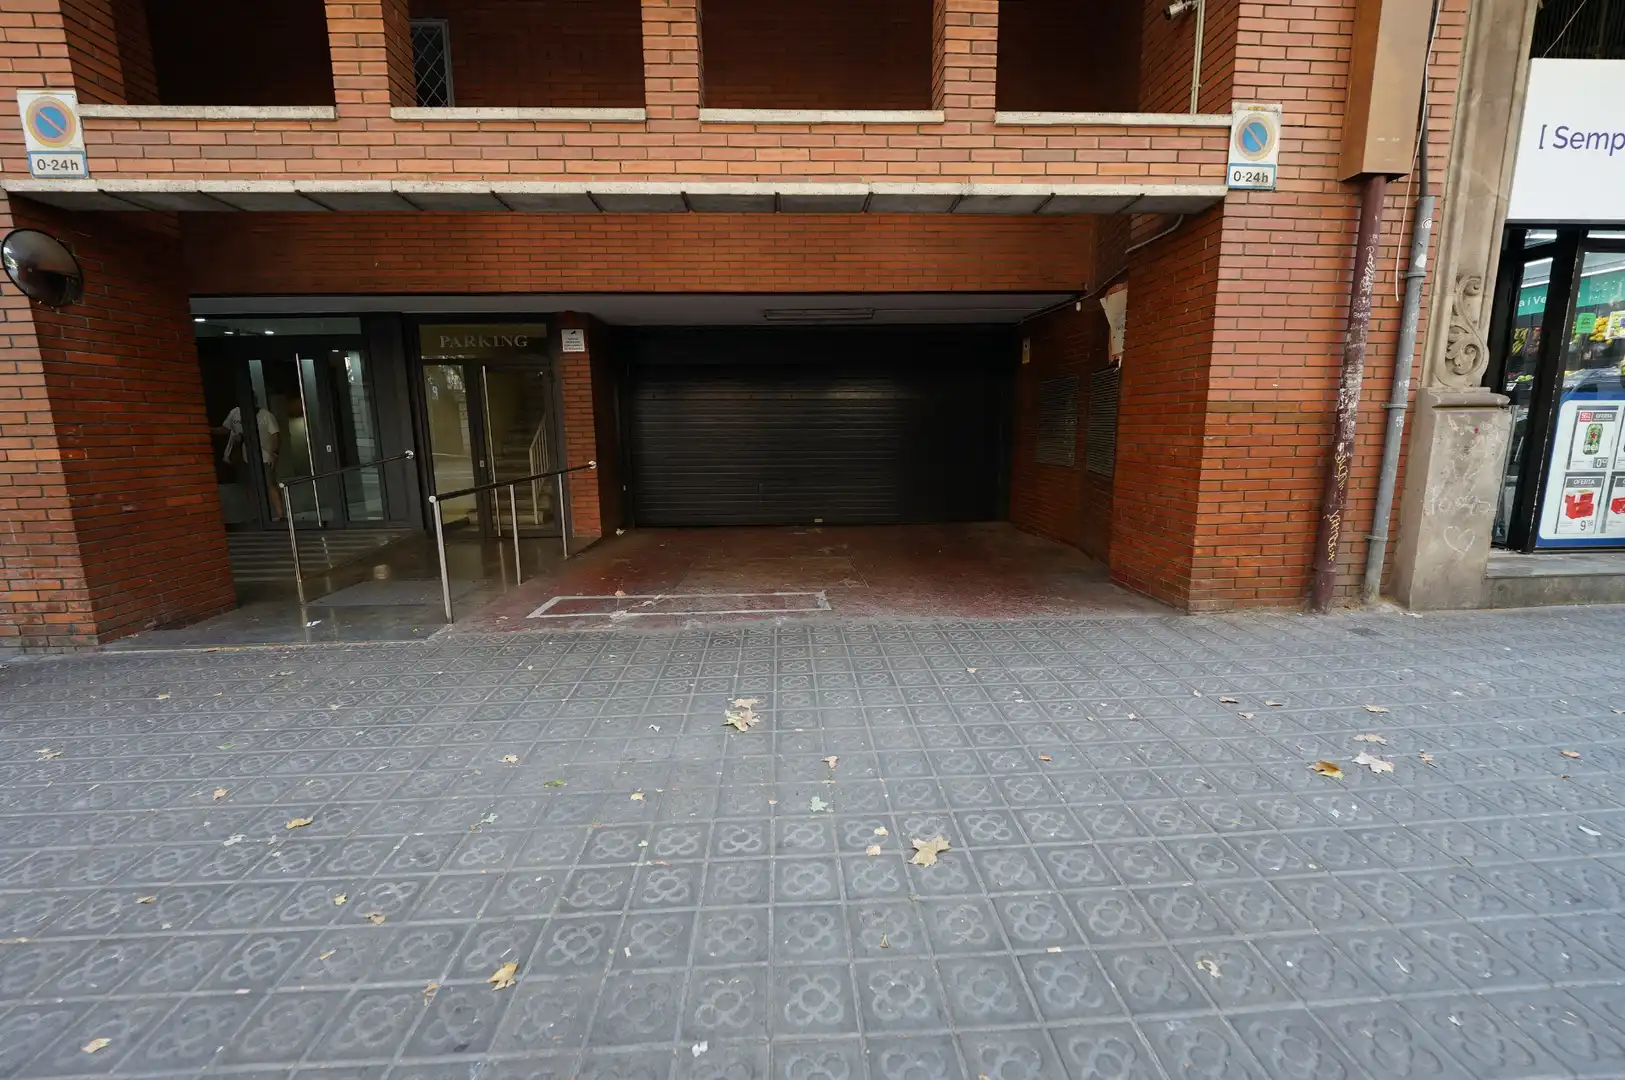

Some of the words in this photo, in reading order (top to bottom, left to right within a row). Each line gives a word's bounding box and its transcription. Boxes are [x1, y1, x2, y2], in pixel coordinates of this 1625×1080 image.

[1552, 125, 1625, 156] Semp
[36, 158, 79, 171] 0-24h
[1233, 170, 1269, 183] 0-24h
[439, 334, 528, 348] PARKING
